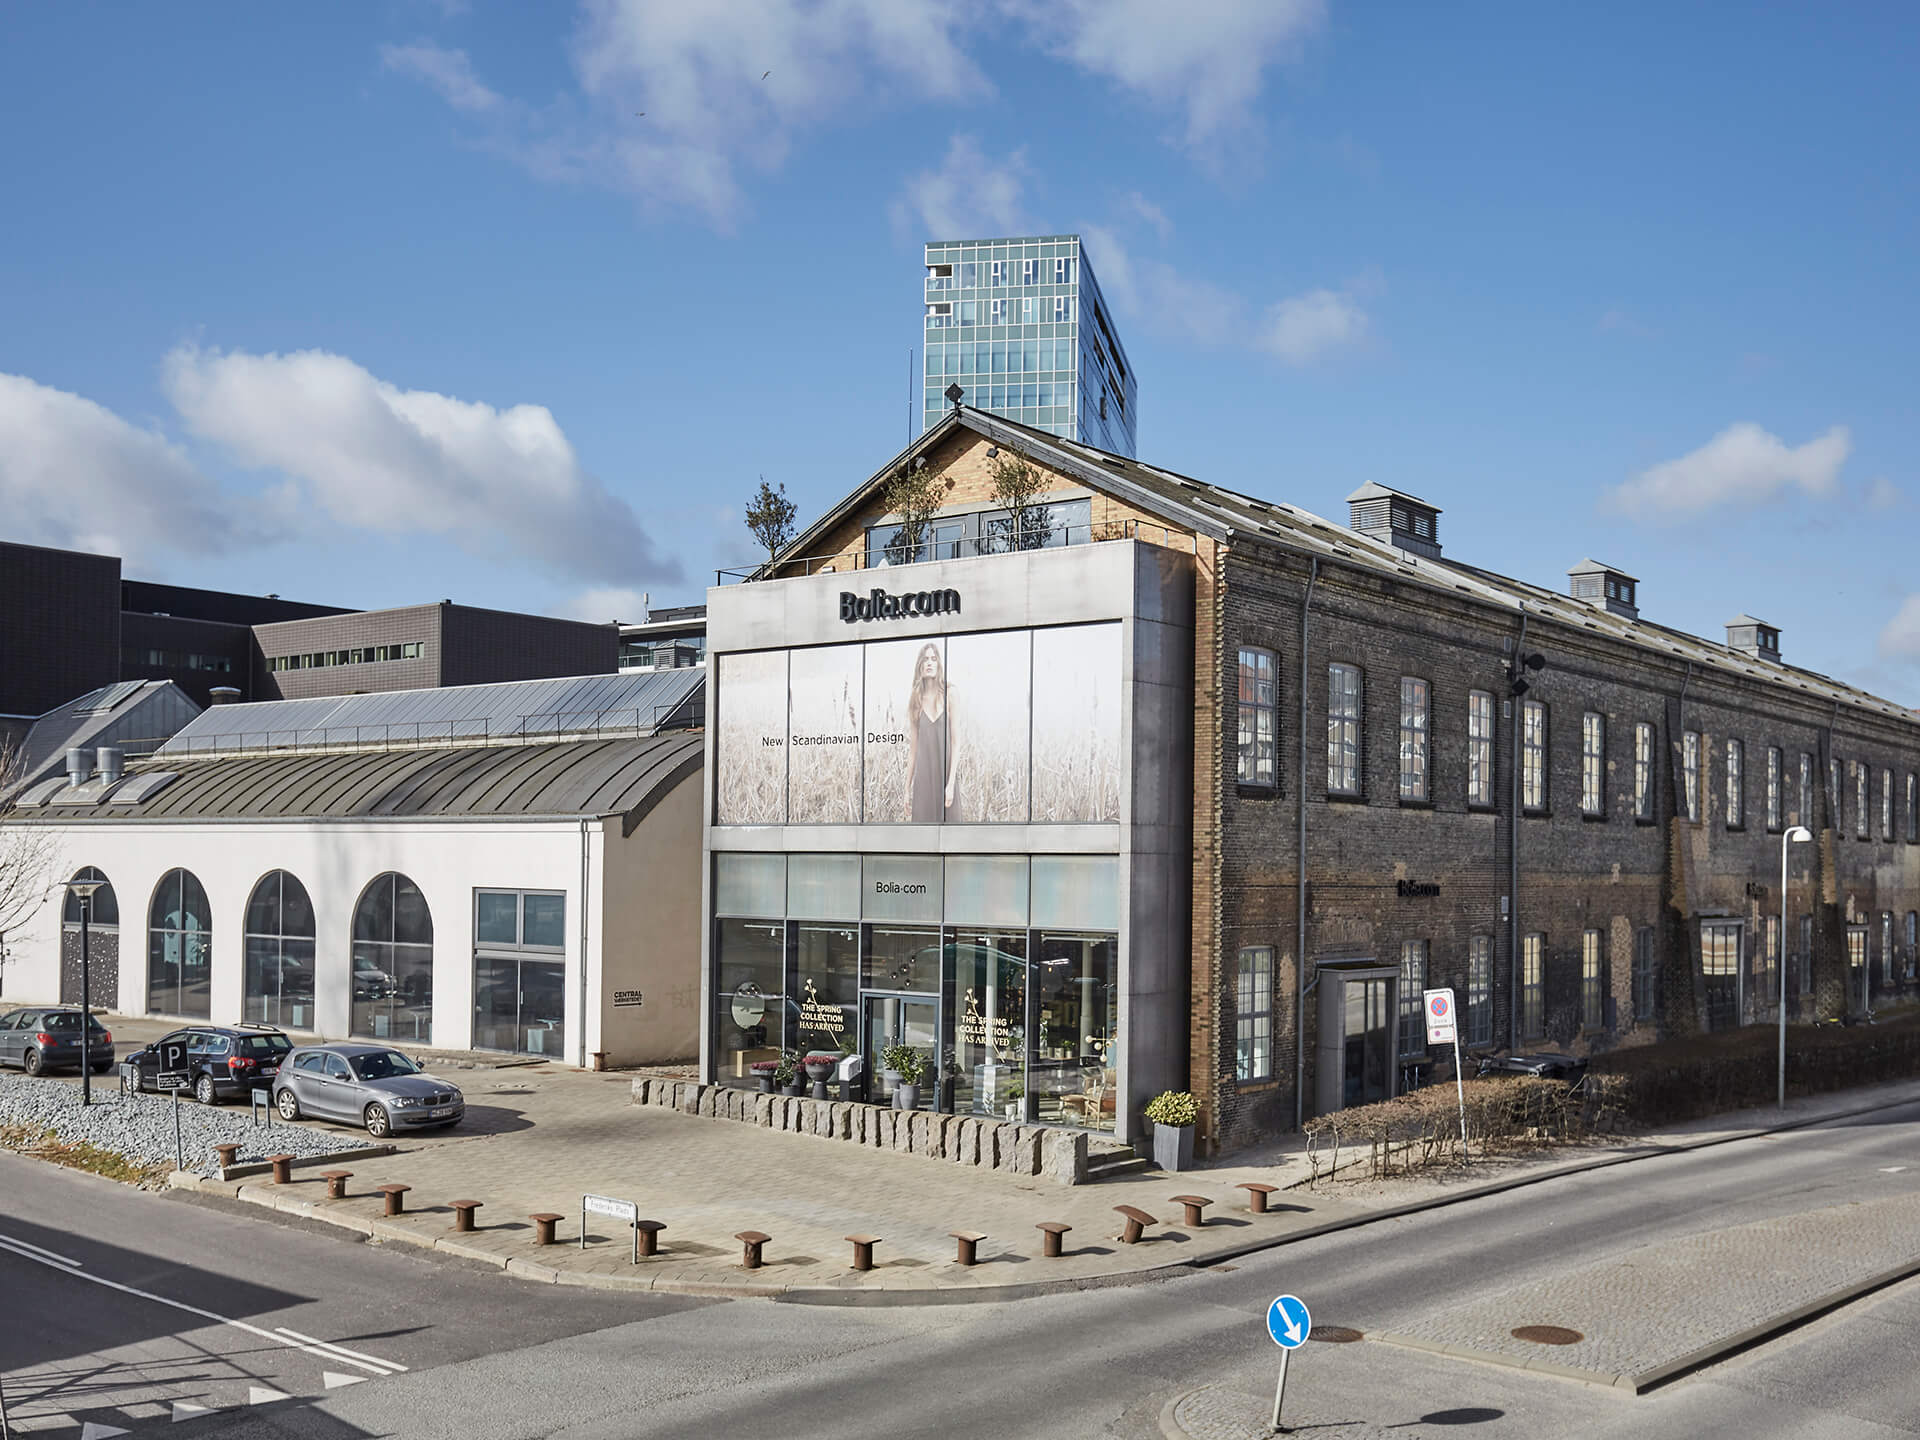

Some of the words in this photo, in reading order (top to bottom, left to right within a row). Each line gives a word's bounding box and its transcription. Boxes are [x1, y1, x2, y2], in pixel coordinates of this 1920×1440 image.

[839, 588, 961, 624] Bolia.com
[762, 736, 784, 747] New
[791, 733, 859, 746] Scandinavian
[867, 731, 904, 745] Design
[614, 990, 643, 998] CENTRAL
[801, 1003, 816, 1012] THE
[816, 1004, 842, 1014] SPRING
[800, 1012, 844, 1023] COLLECTION
[961, 1015, 977, 1025] THE
[800, 1021, 814, 1030] HAS
[813, 1022, 845, 1032] ARRIVED
[958, 1033, 975, 1043] HAS
[975, 1035, 1010, 1046] ARIVED
[168, 1046, 180, 1068] P
